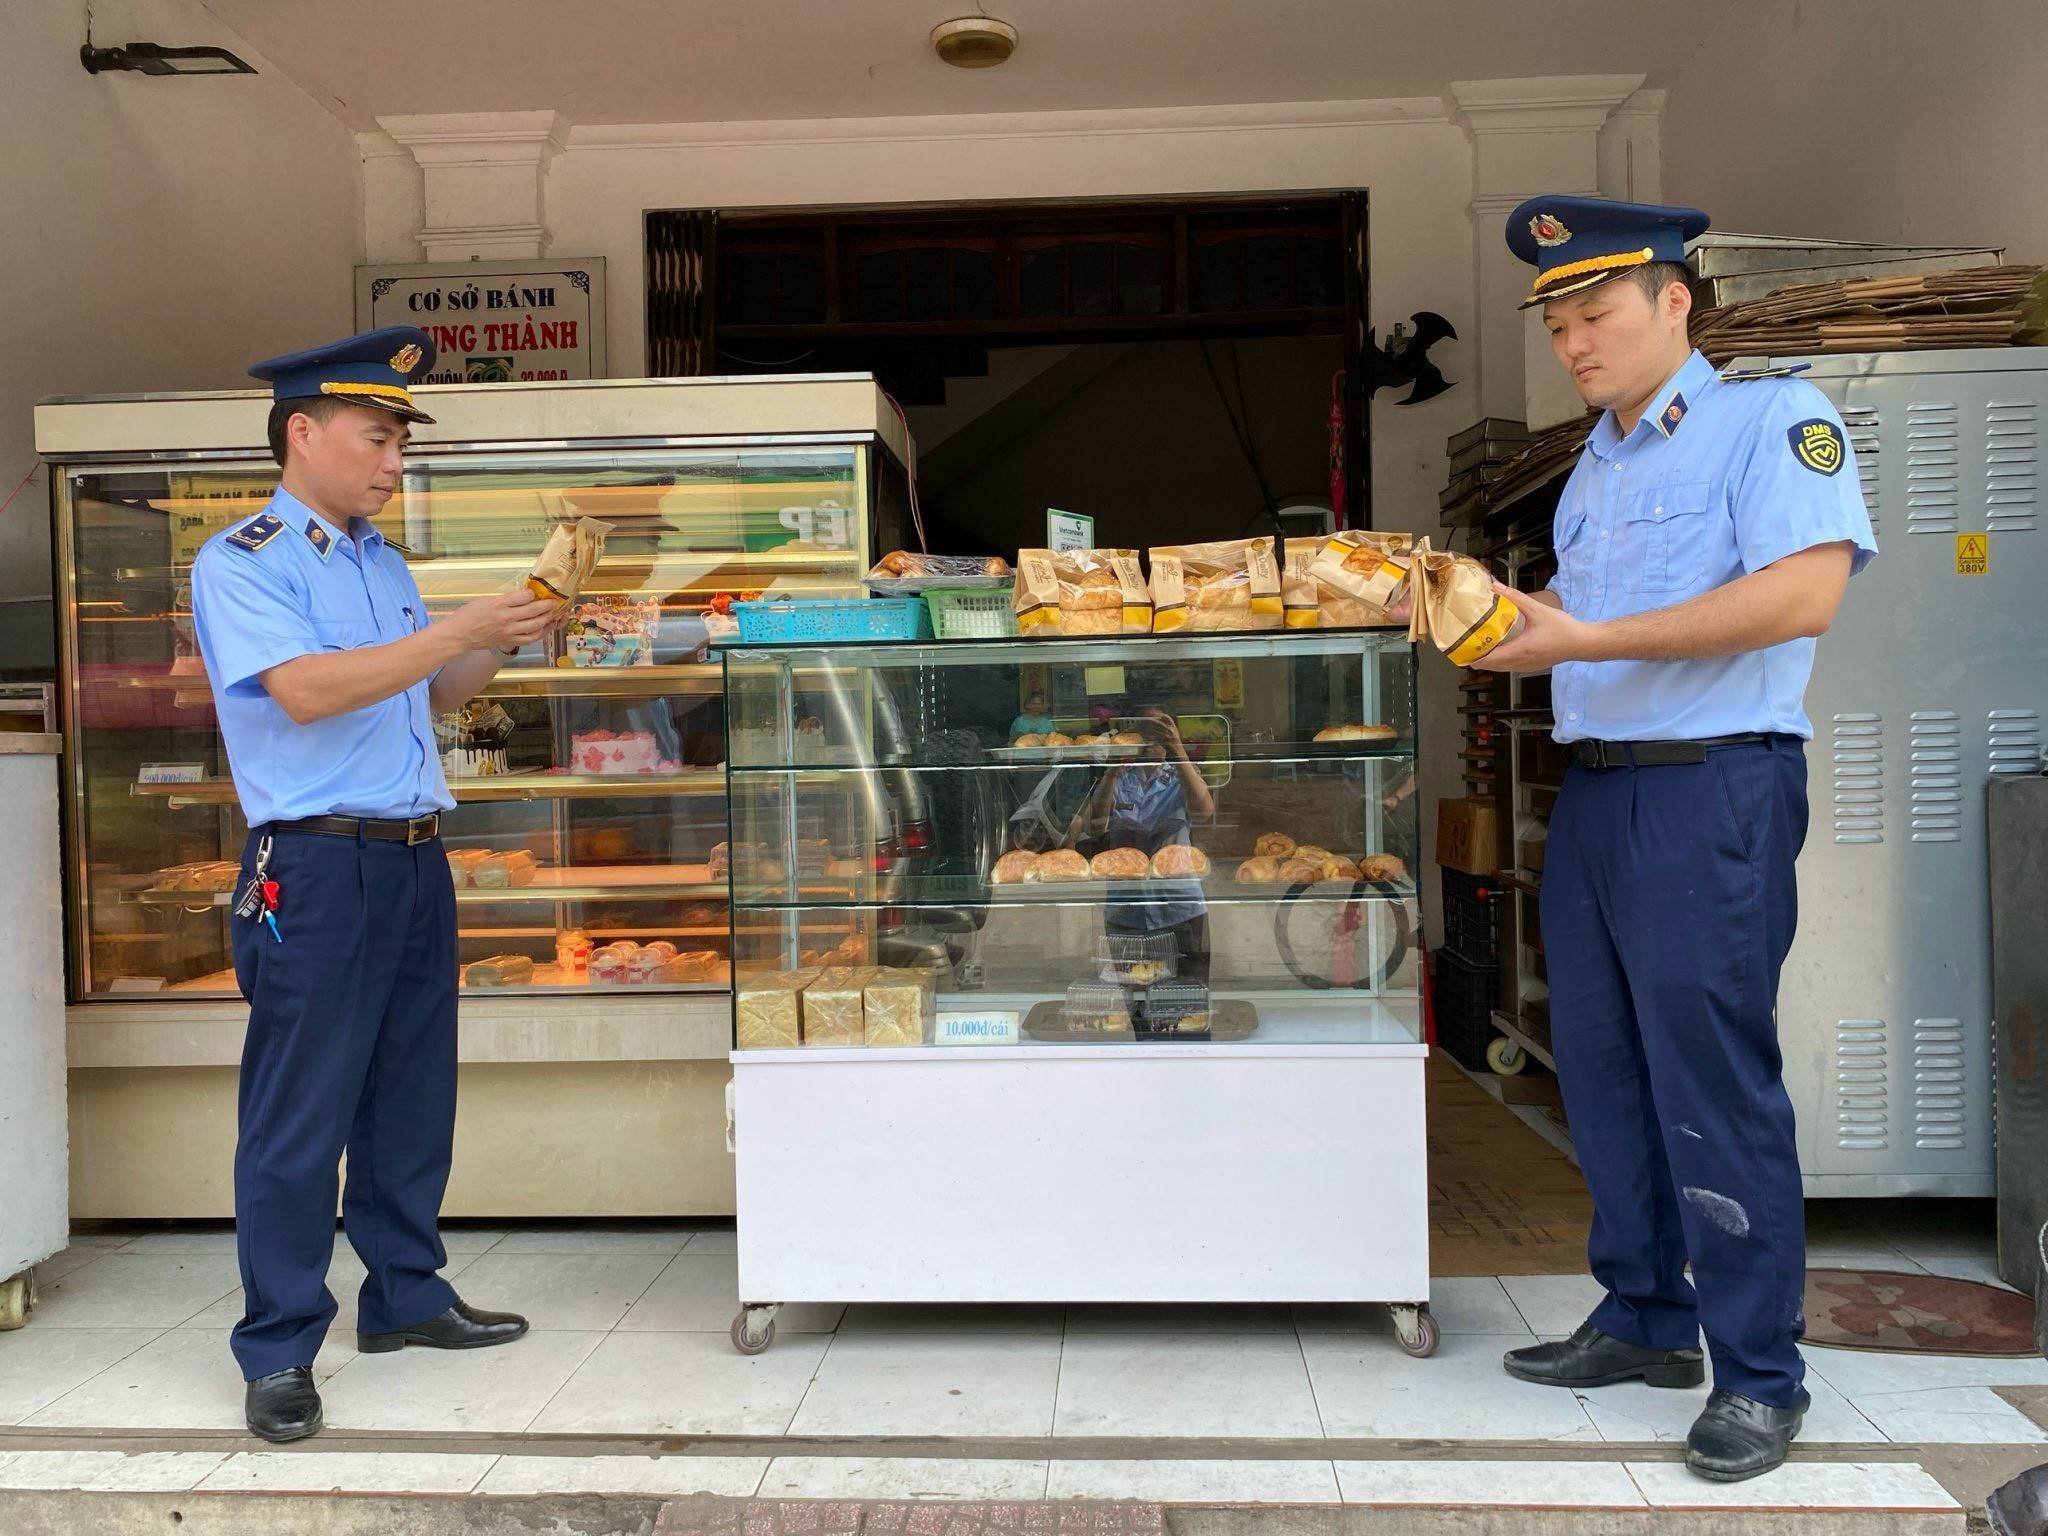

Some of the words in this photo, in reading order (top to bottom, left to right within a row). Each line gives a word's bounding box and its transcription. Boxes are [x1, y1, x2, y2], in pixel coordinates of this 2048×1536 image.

[408, 288, 441, 312] CƠ
[447, 283, 480, 311] SỞ
[486, 283, 556, 310] BÁNH
[484, 314, 578, 352] THÀNH
[1802, 424, 1832, 437] DMS
[1959, 564, 1985, 573] 380V
[945, 1019, 1009, 1036] 10.000đ/cái
